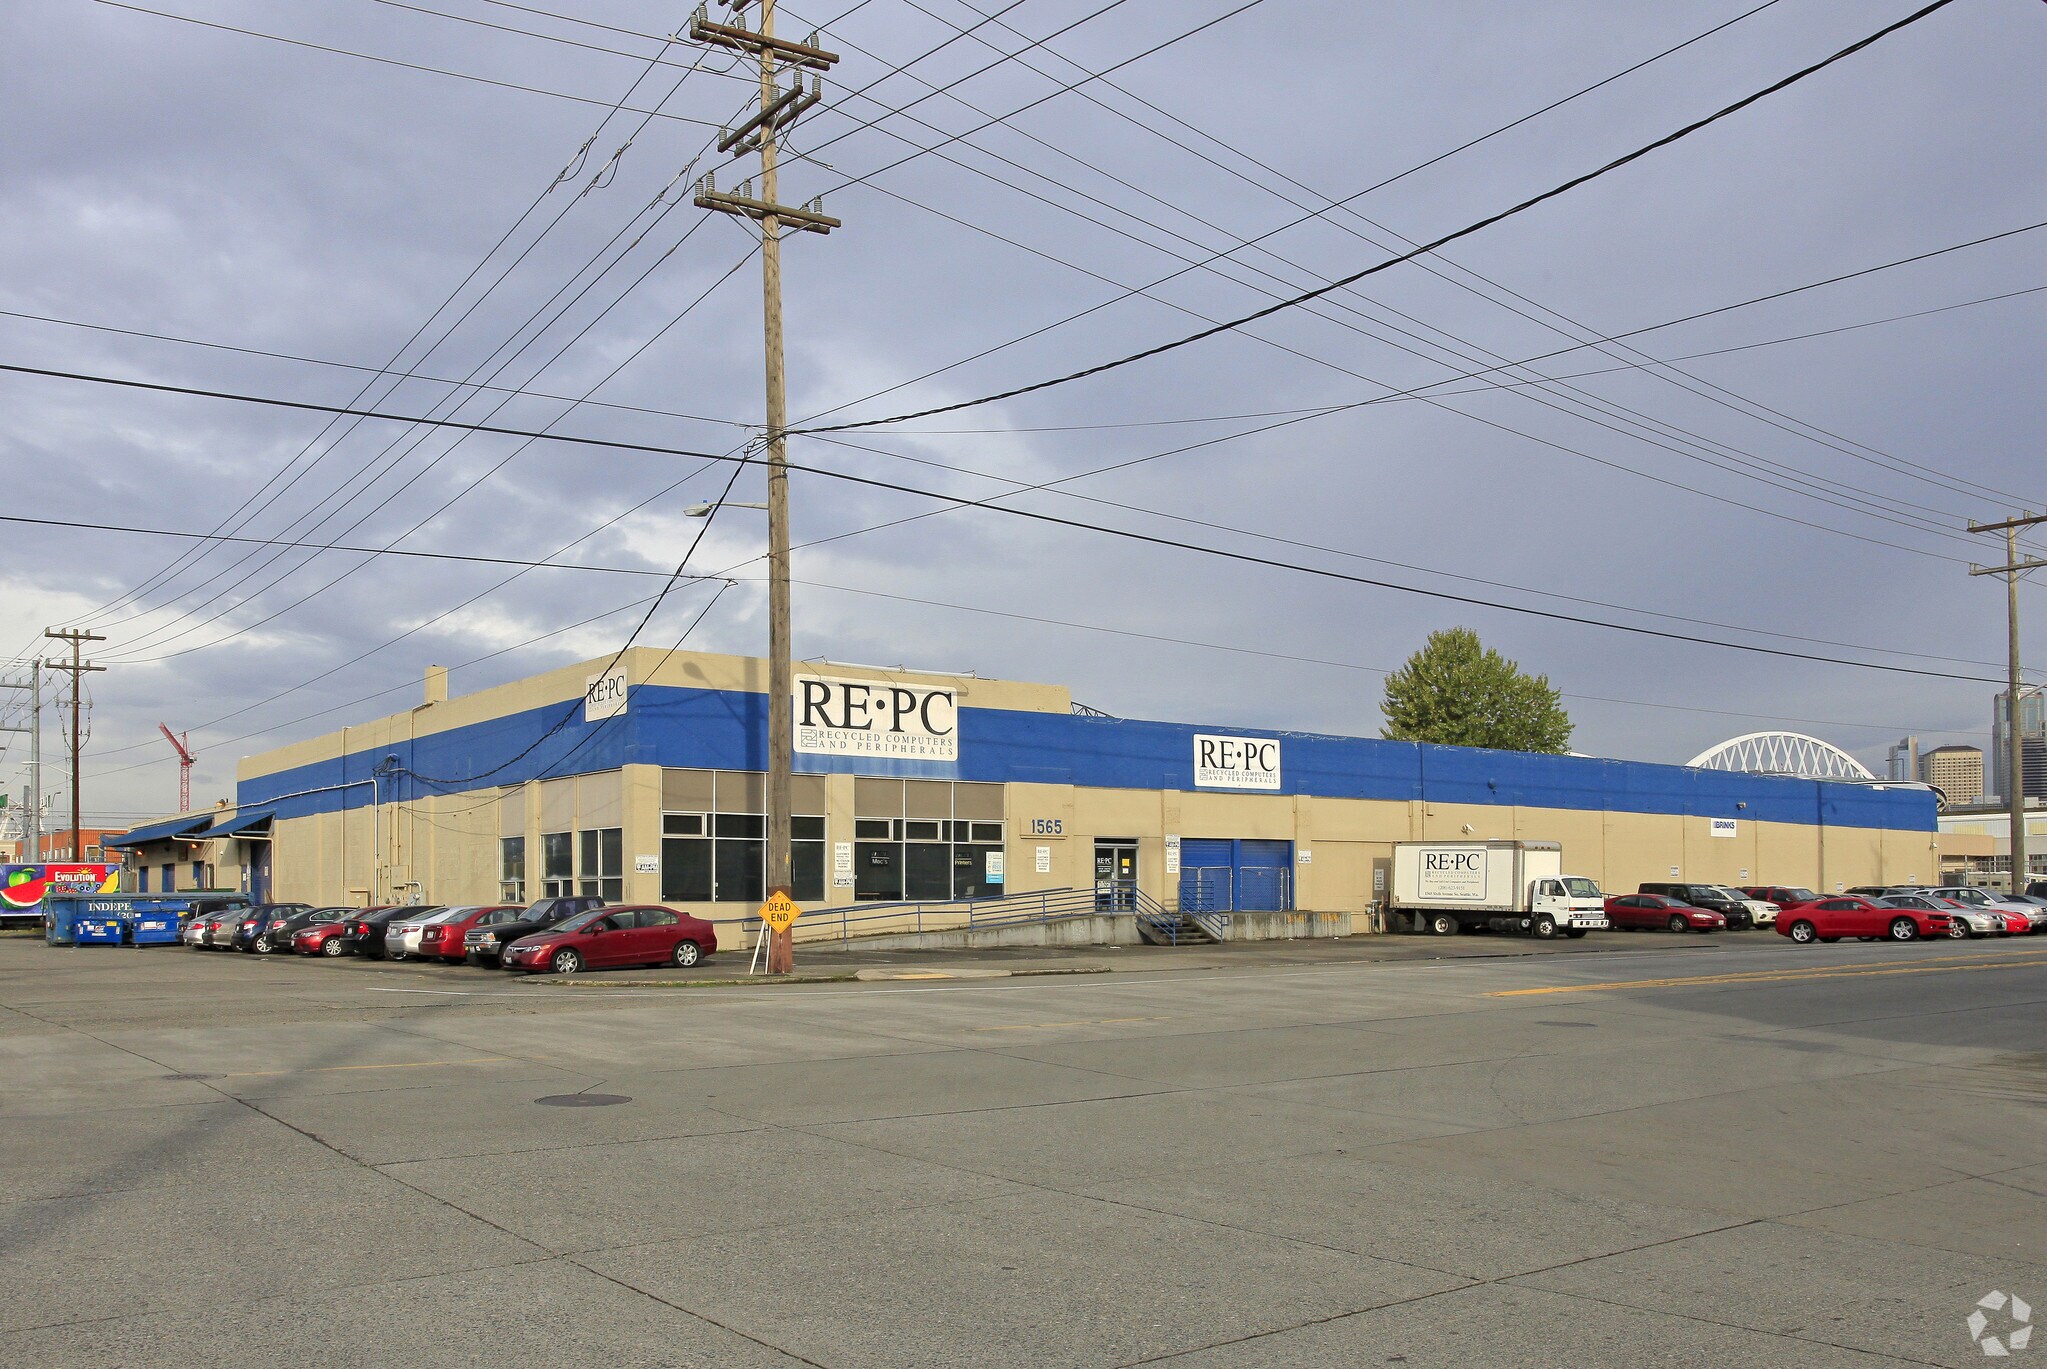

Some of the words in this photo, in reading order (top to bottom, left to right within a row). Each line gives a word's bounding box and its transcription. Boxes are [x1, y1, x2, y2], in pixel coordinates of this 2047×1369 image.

[818, 730, 881, 742] RECYCLED
[885, 734, 953, 747] COMPUTERS
[818, 740, 847, 749] AND
[857, 742, 953, 756] PERIPHERALS
[1208, 769, 1239, 777] RECYCLED
[1241, 770, 1276, 778] COMPUTERS
[1227, 775, 1277, 784] PERIPHERALS
[1031, 819, 1062, 834] 1565
[768, 902, 791, 912] DEAD
[770, 913, 789, 922] END
